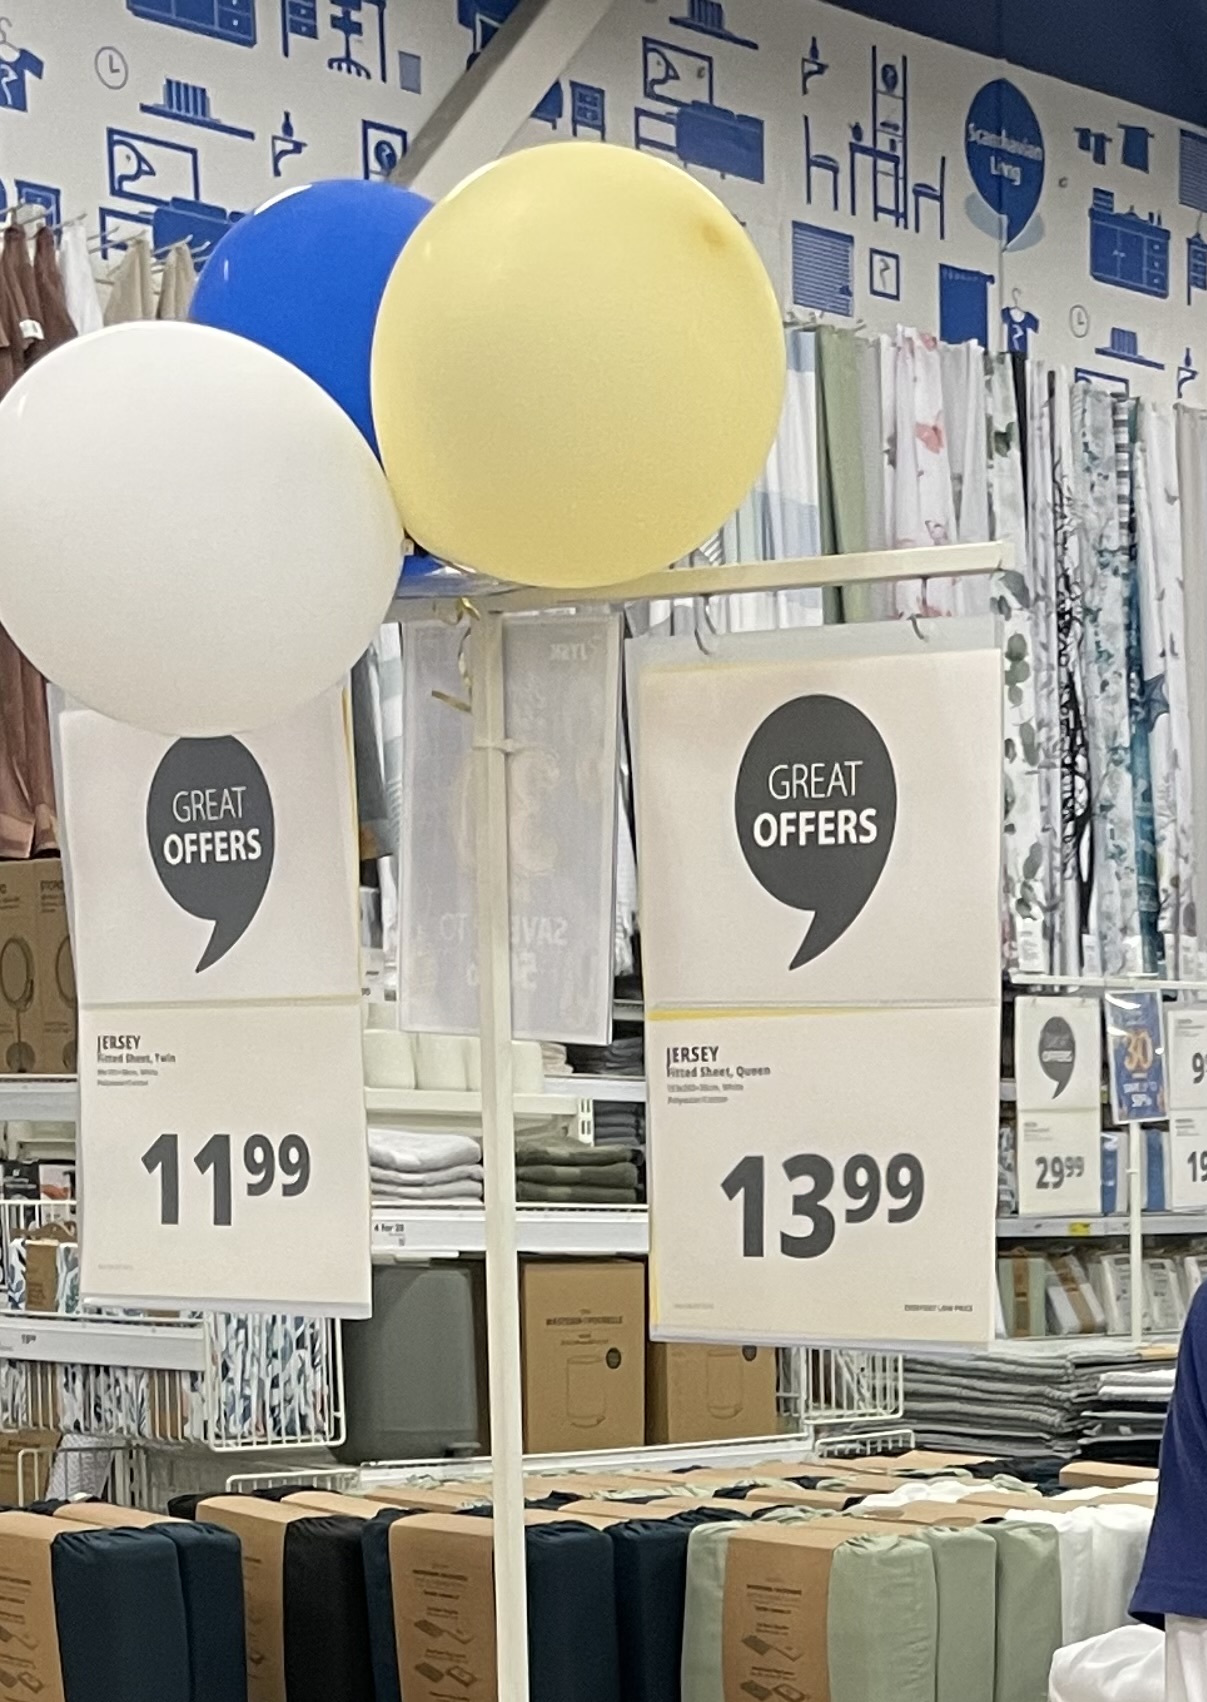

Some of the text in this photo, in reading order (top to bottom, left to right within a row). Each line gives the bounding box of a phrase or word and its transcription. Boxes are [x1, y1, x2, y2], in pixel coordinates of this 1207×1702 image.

[768, 760, 864, 800] GREAT
[172, 786, 247, 823] GREAT
[753, 808, 878, 848] OFFERS
[163, 828, 262, 866] OFFERS
[97, 1035, 141, 1053] JERSEY
[666, 1046, 719, 1067] JERSEY
